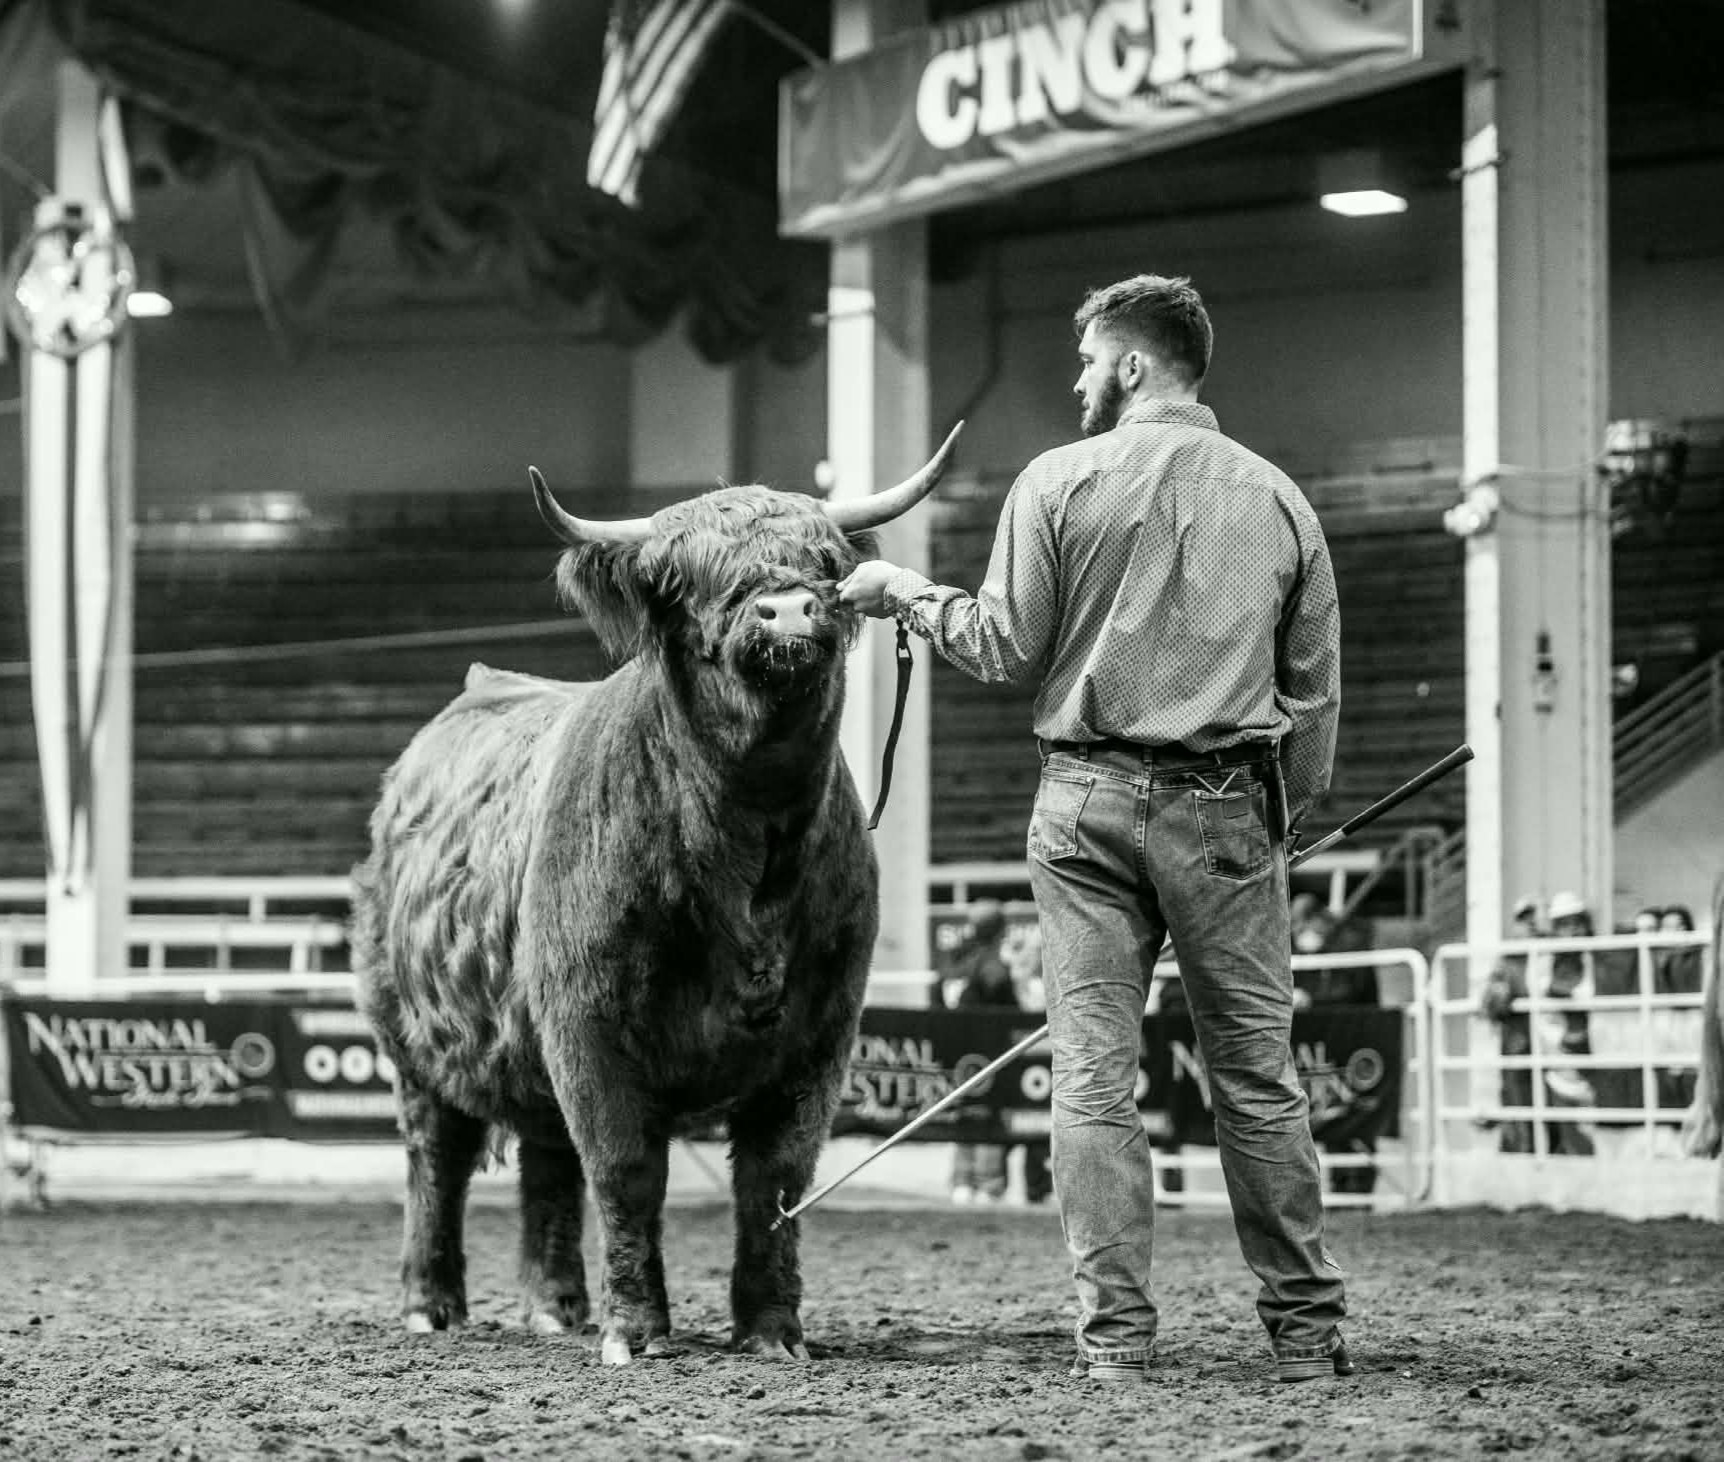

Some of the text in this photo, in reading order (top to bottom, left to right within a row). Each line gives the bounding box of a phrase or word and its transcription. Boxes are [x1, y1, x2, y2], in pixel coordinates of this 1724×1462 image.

[916, 0, 1237, 148] CINCH
[24, 1012, 217, 1054] NATIONAL
[54, 1048, 240, 1090] WESTERN
